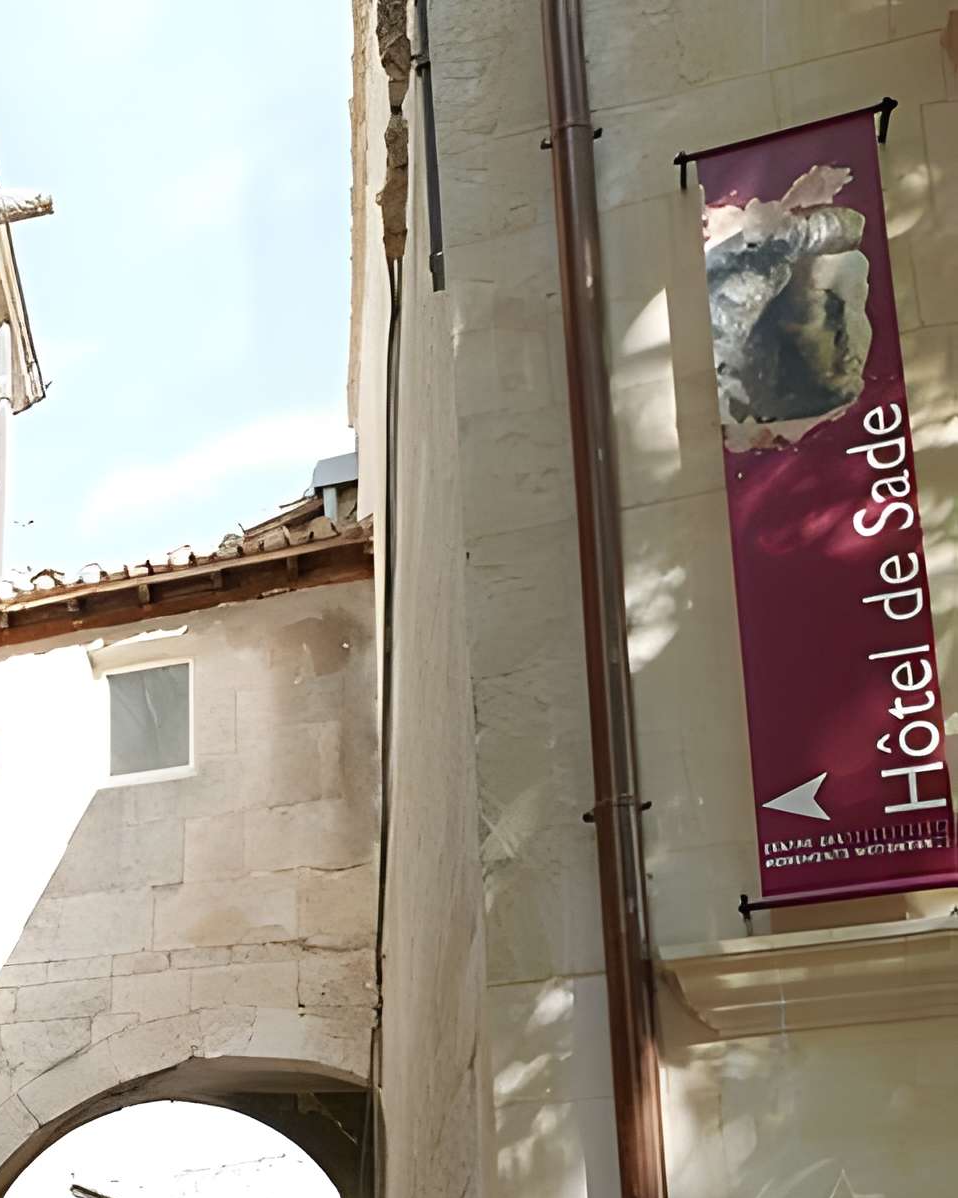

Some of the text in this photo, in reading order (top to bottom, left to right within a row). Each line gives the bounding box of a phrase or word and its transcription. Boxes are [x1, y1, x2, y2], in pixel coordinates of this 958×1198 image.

[846, 403, 947, 814] Hôtel de Sade
